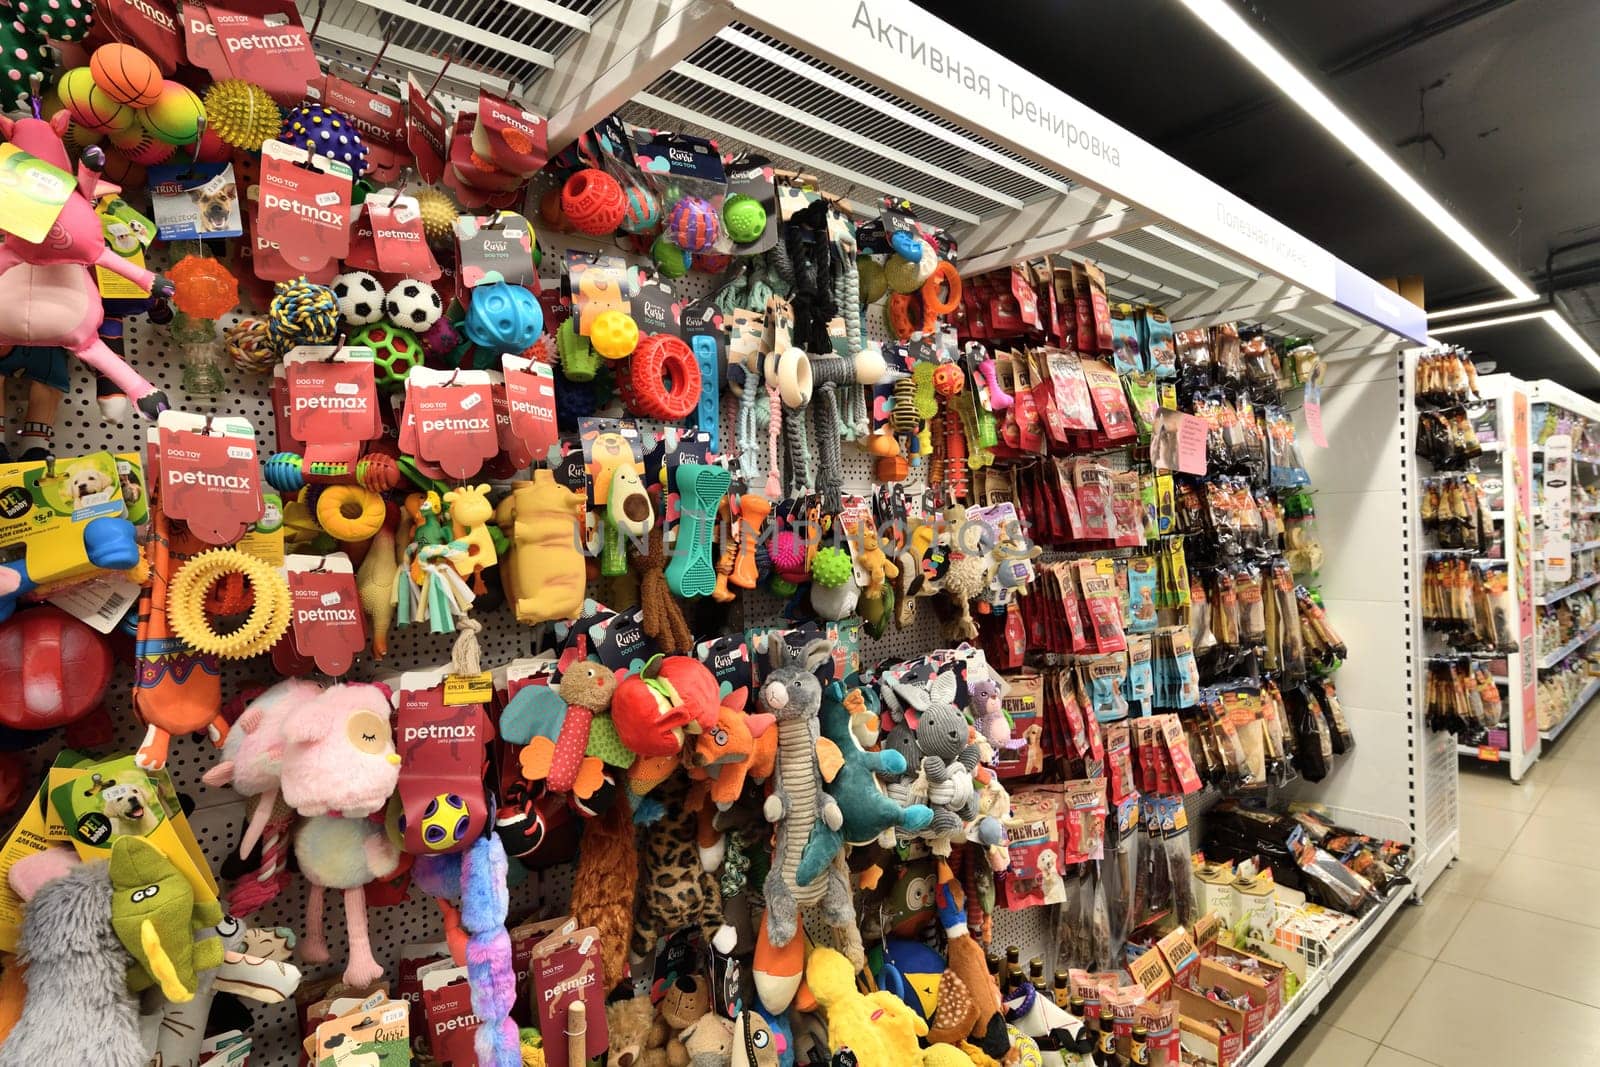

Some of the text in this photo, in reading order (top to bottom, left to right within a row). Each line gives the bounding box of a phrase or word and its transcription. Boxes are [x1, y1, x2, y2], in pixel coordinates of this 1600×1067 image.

[226, 33, 304, 52] petmax
[852, 0, 1120, 167] Активная тренировка
[492, 110, 535, 136] petmax
[156, 184, 183, 193] TRIXIE
[266, 174, 299, 189] DOG TOY
[264, 193, 344, 226] petmax
[377, 229, 420, 241] petmax
[296, 394, 367, 410] petmax
[511, 400, 553, 418] petmax
[422, 416, 490, 433] petmax
[168, 449, 201, 458] DOG TOY
[169, 469, 250, 489] petmax
[298, 608, 356, 624] petmax
[1001, 697, 1035, 712] HEWELL
[405, 724, 476, 742] petmax
[553, 964, 564, 972] TOY
[544, 972, 595, 1001] petmax
[1078, 987, 1100, 999] CHEW
[432, 1001, 458, 1012] DOG TOY
[435, 1013, 482, 1035] petm
[374, 1027, 404, 1044] Rurri
